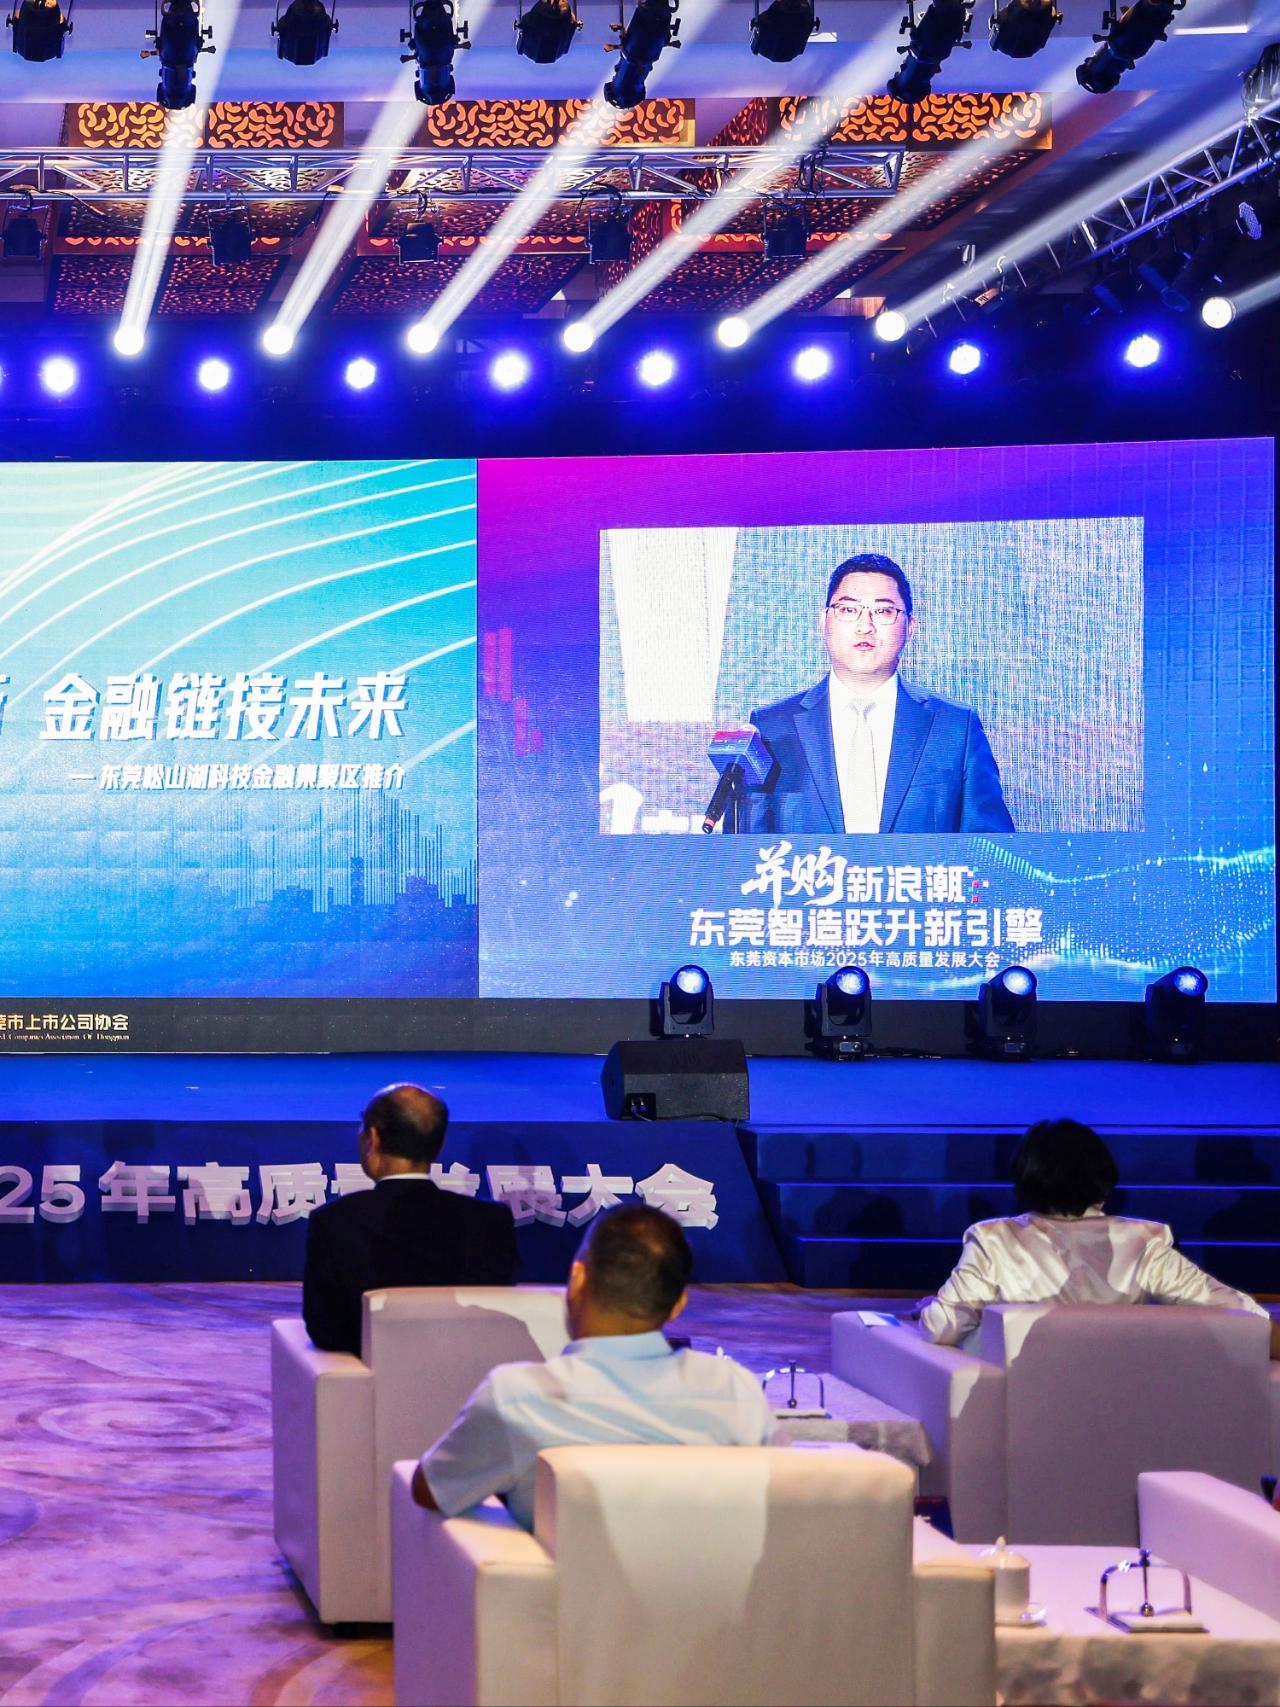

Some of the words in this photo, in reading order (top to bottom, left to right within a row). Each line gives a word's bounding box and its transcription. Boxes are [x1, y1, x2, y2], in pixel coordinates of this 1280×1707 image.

[39, 671, 407, 740] 金融链接未来
[741, 841, 967, 906] 并购新浪潮
[689, 907, 1043, 947] 东莞智造跃升新引擎
[729, 950, 1000, 969] 东莞资本市场2025年高质量发展大会
